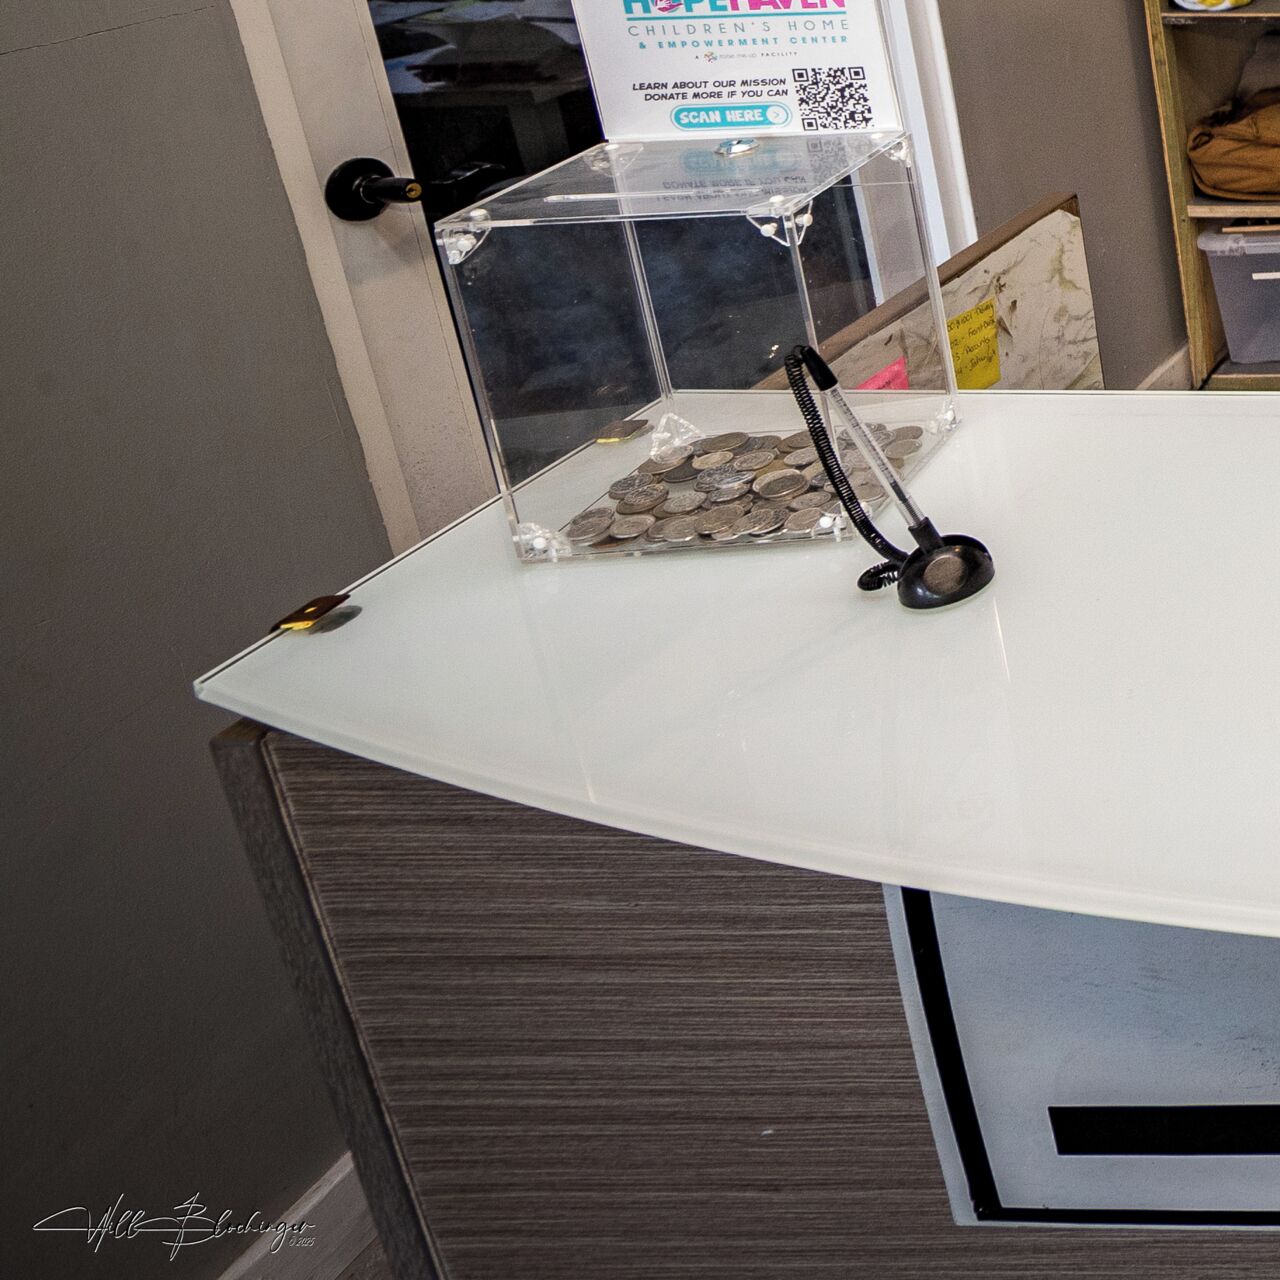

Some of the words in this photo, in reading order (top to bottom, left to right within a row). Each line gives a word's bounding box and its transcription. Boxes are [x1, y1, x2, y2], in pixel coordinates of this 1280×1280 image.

[627, 20, 771, 37] CHILDREN'S
[788, 18, 850, 32] HOME
[638, 40, 647, 50] &
[658, 37, 780, 49] EMPOWERMENT
[790, 35, 848, 45] CENTER
[632, 80, 668, 92] LEARN
[672, 80, 709, 90] ABOUT
[713, 80, 736, 89] OUR
[740, 78, 786, 88] MISSION
[644, 91, 690, 102] DONATE
[692, 90, 723, 100] MORE
[726, 90, 738, 100] IF
[740, 90, 763, 99] YOU
[766, 88, 788, 98] CAN
[679, 108, 722, 124] SCAN
[726, 108, 764, 123] HERE
